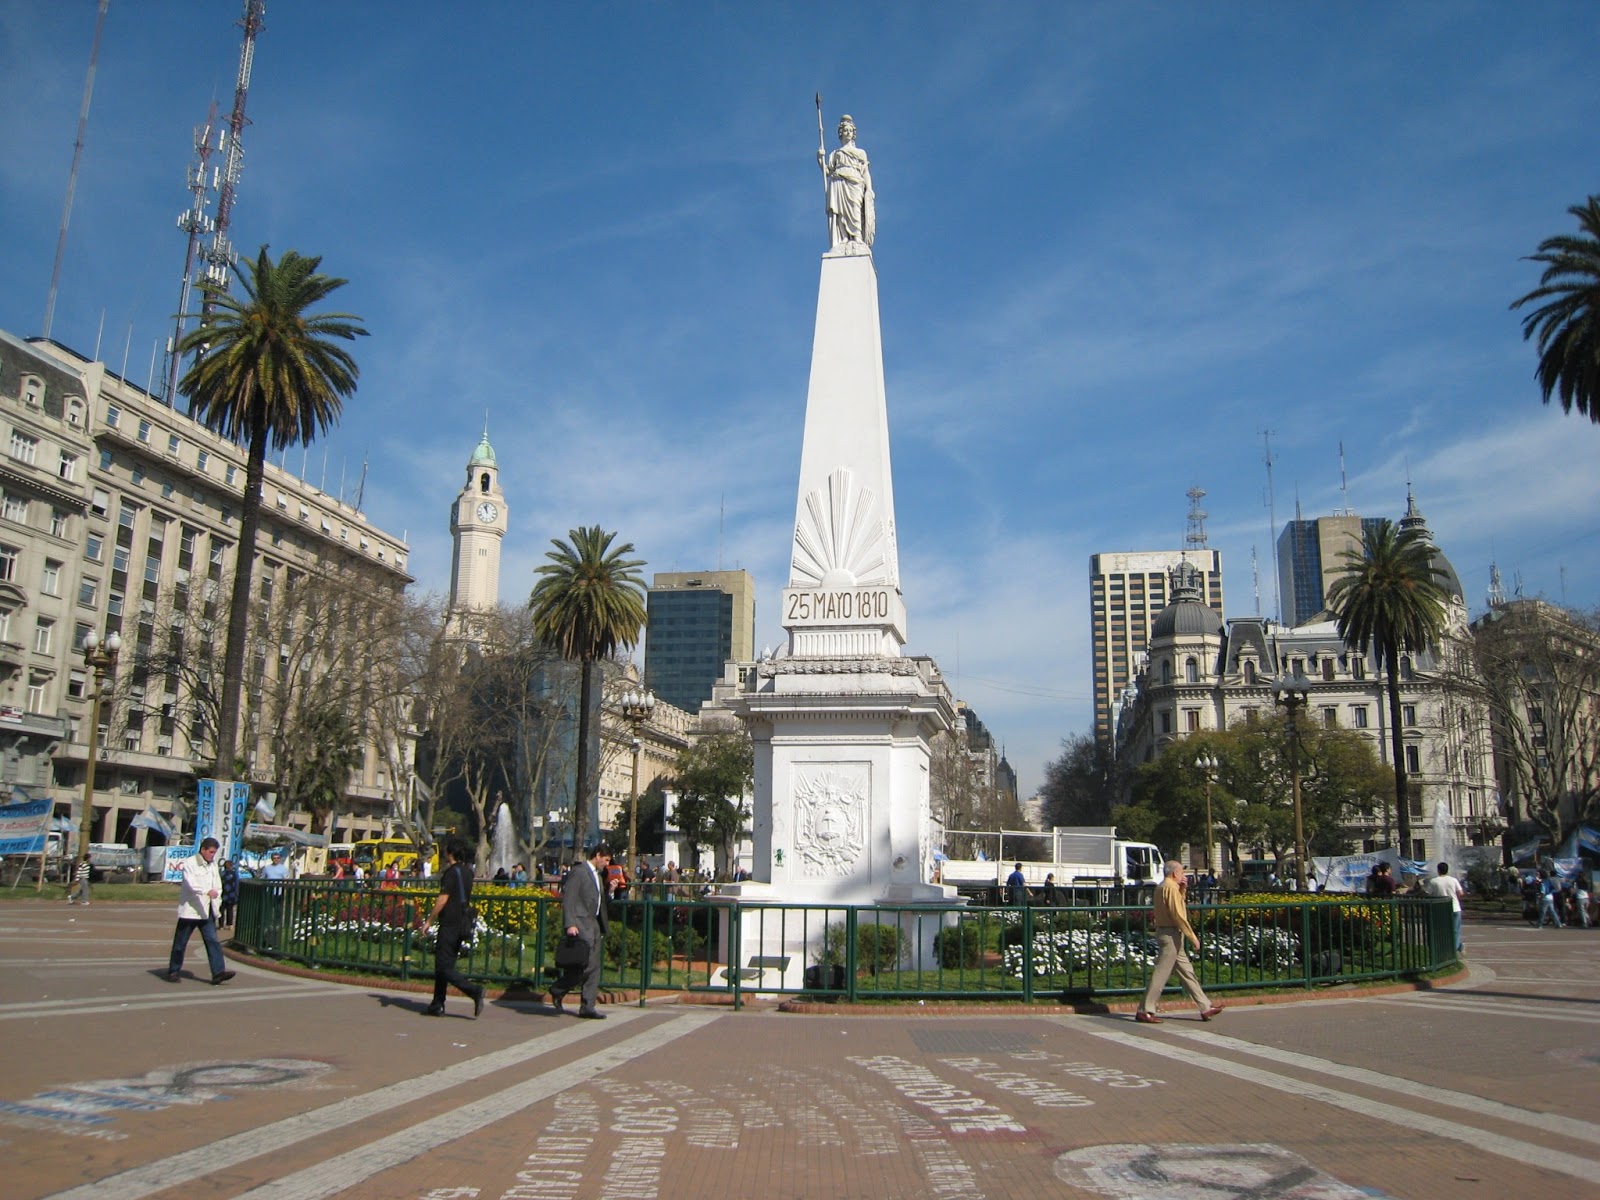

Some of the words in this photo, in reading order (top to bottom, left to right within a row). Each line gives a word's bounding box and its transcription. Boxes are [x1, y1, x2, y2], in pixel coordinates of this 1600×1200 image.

[788, 593, 810, 620] 25
[813, 592, 852, 619] MAYO
[855, 591, 888, 619] 1810
[201, 786, 212, 837] MEMO
[217, 788, 231, 876] JUSTIC
[845, 1056, 972, 1098] SEGUIMOS
[974, 1072, 1096, 1107] CASINO
[609, 1105, 680, 1134] 500
[914, 1097, 1001, 1114] DE
[942, 1114, 1027, 1133] PIE
[536, 1136, 595, 1150] EN
[524, 1153, 587, 1166] LA
[600, 1136, 667, 1200] TRABAJADOR
[499, 1168, 583, 1200] CALL
